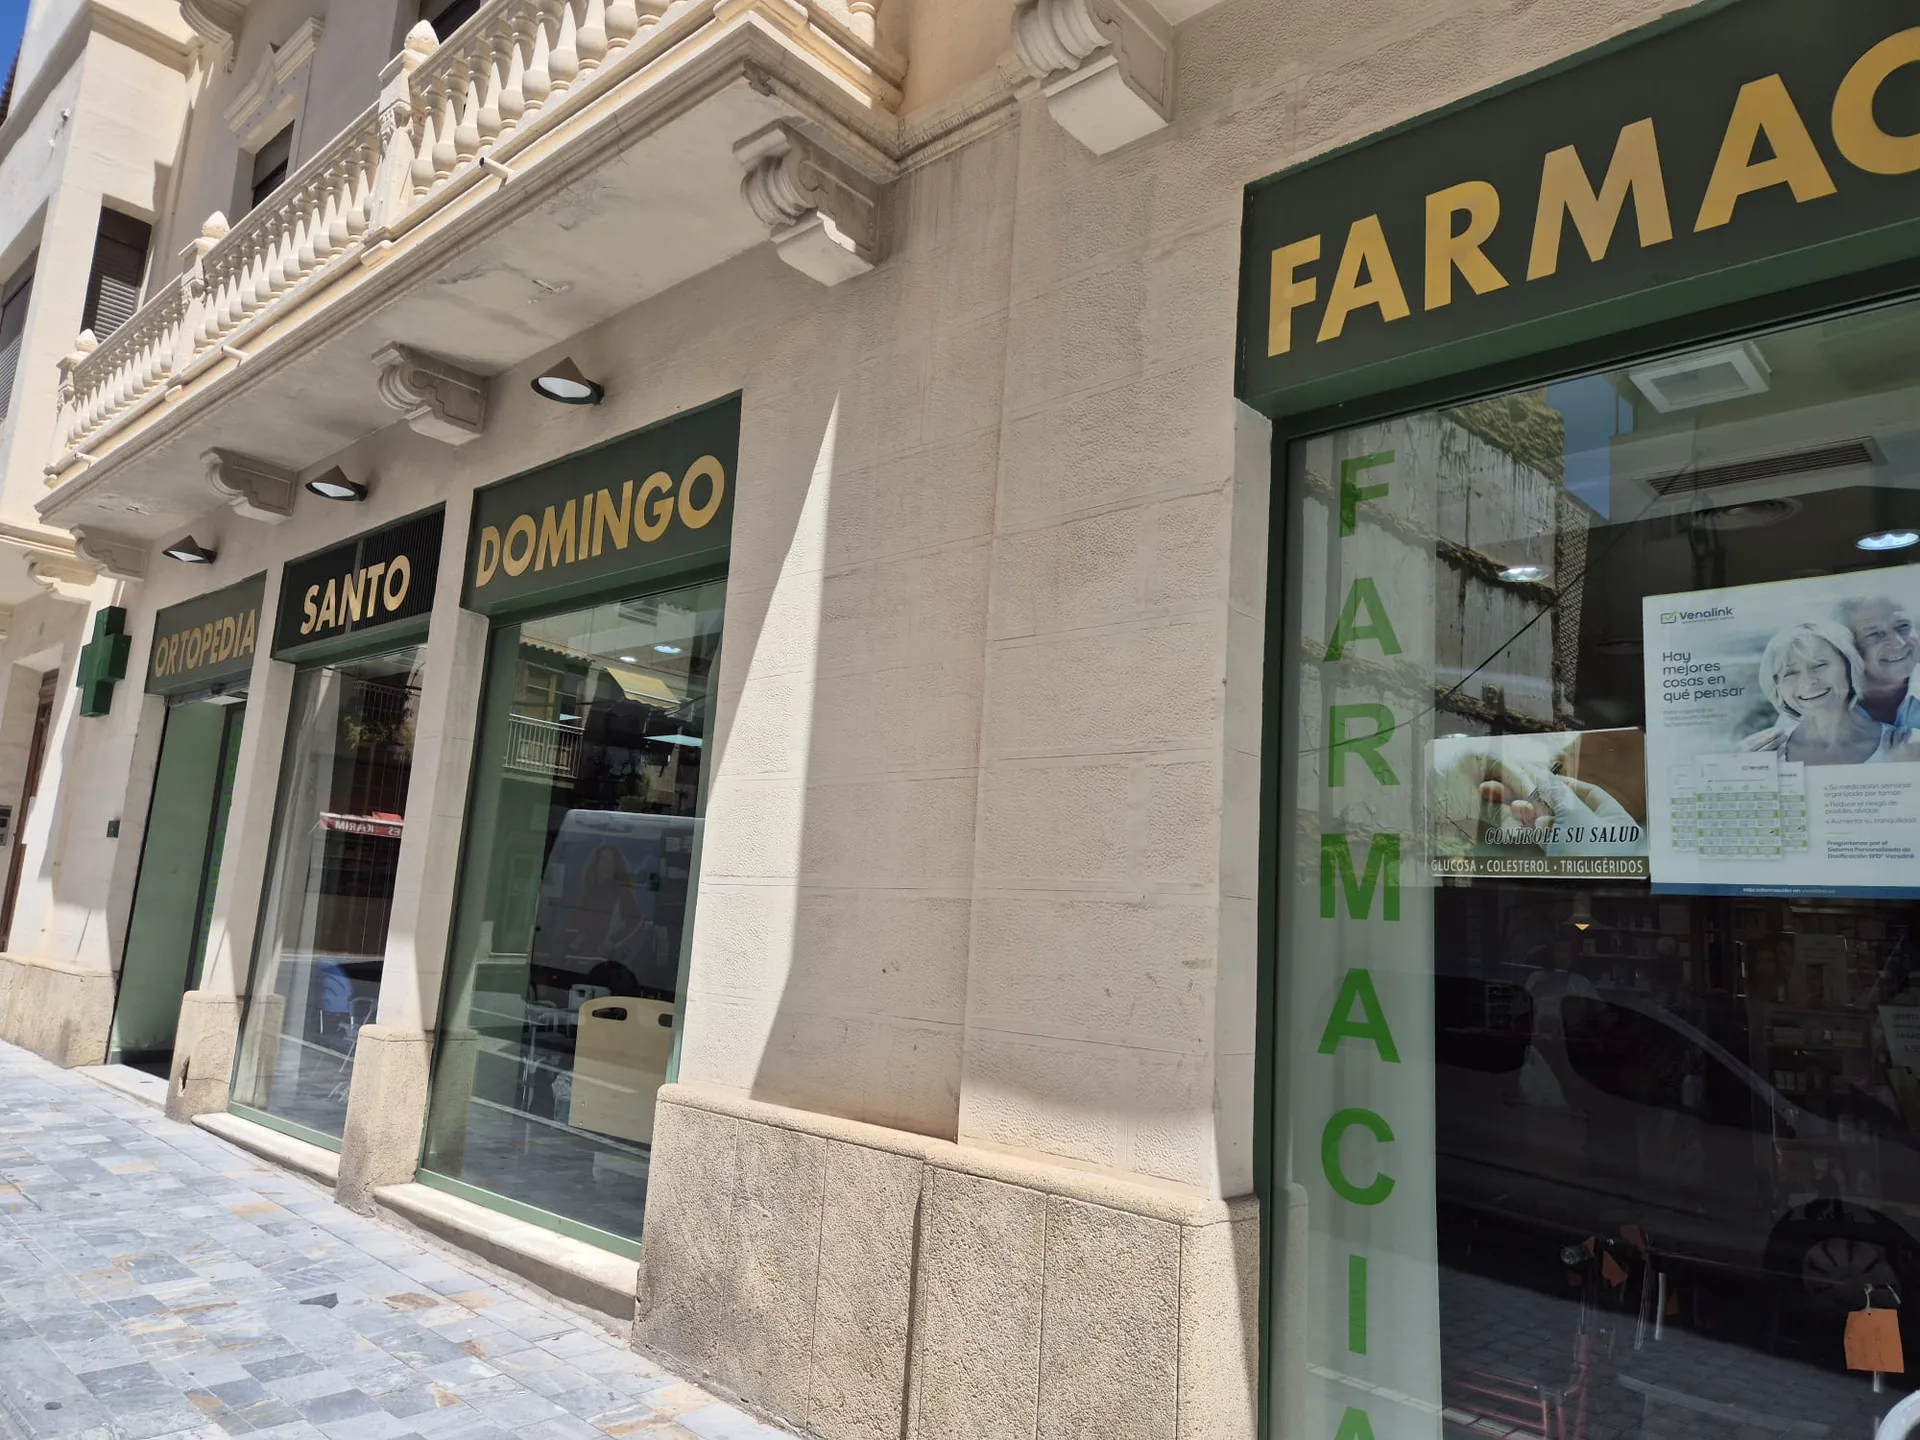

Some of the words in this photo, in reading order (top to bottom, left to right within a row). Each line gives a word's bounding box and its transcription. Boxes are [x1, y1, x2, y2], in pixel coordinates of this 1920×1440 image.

[475, 454, 725, 588] DOMINGO
[299, 554, 411, 635] SANTO
[1679, 606, 1734, 619] Venalink
[154, 608, 256, 678] ORTOPEDIA
[1662, 651, 1691, 663] Hay
[1663, 662, 1721, 676] mejores
[1663, 676, 1704, 689] cosas
[1707, 675, 1726, 685] en
[1663, 688, 1690, 704] qué
[1694, 687, 1746, 702] pensar
[1484, 826, 1560, 845] CONTROLE
[1566, 826, 1584, 844] SU
[1589, 825, 1640, 843] SALUD
[1431, 858, 1477, 873] GLUCOSA
[1486, 858, 1551, 873] COLESTEROL
[1560, 857, 1644, 874] TRIGLIGÉRIDOS
